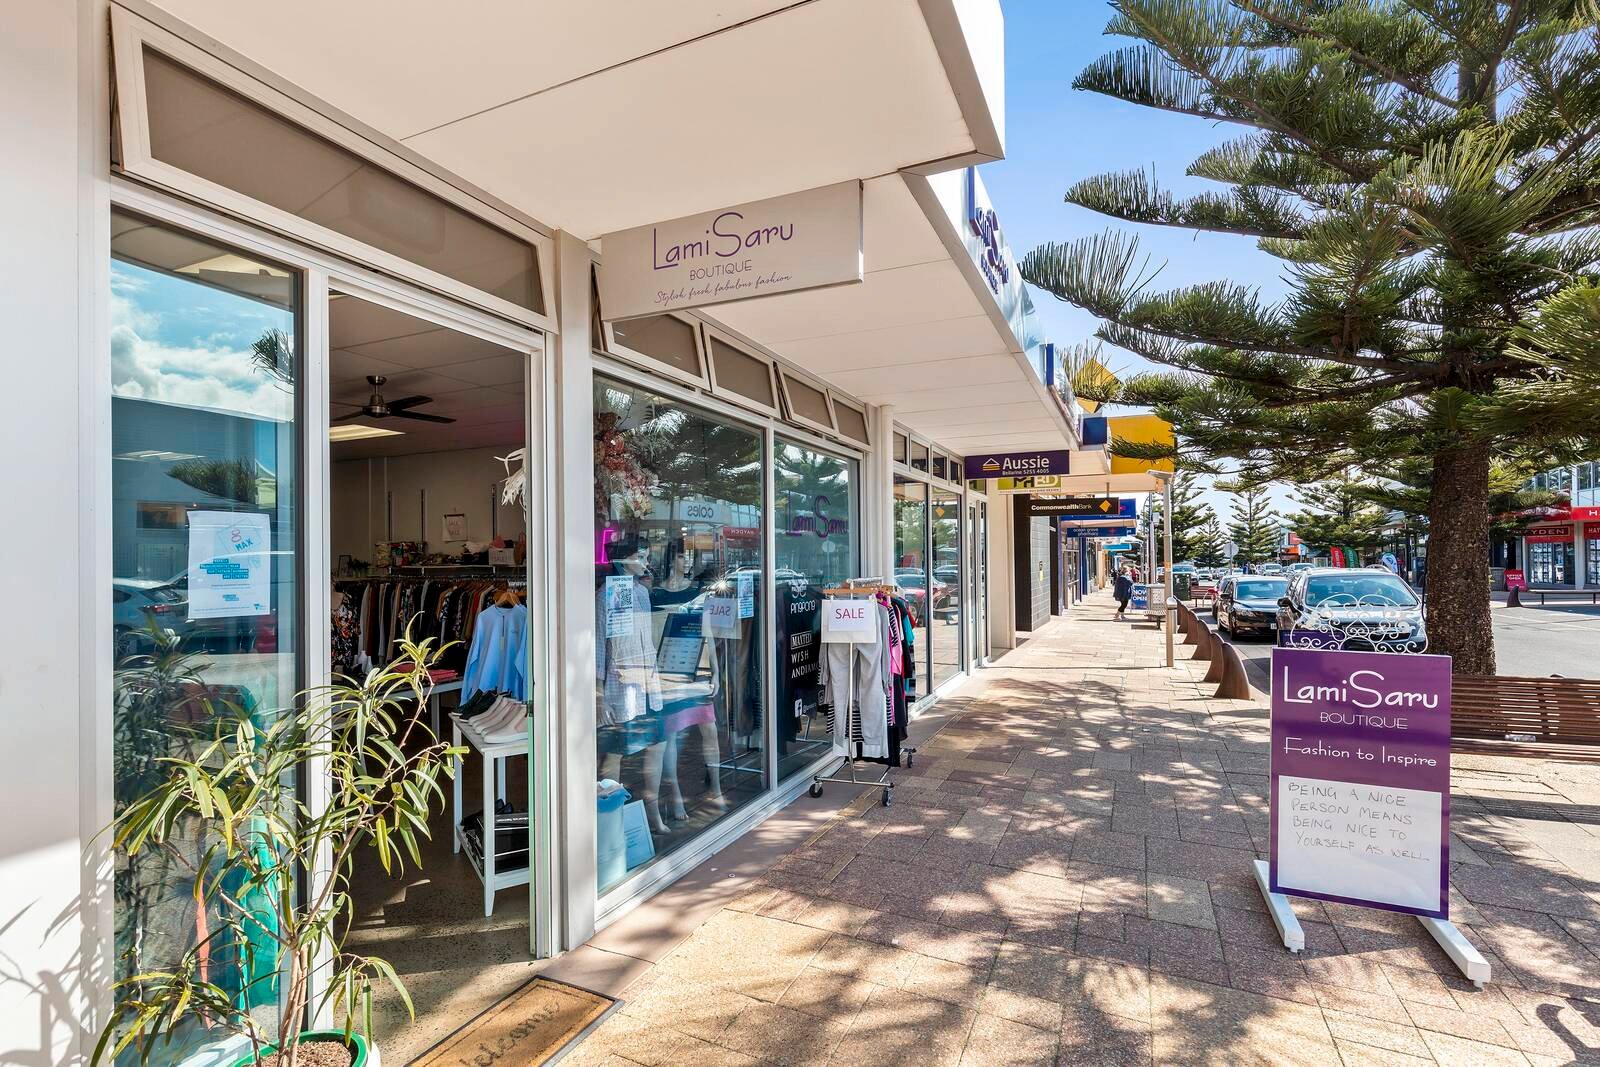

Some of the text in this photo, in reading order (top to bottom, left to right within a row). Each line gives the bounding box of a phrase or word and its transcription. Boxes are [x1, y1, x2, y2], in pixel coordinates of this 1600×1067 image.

[653, 211, 794, 271] LamiSaru
[689, 259, 753, 281] BOUTIQUE
[654, 272, 793, 307] Stylish fresh fabulous fashion
[1002, 455, 1050, 470] Aussie
[1031, 503, 1093, 511] CommonwealthBank
[235, 537, 254, 552] MAX
[835, 607, 865, 620] SALE
[791, 649, 809, 664] WISH
[791, 660, 820, 679] ANDIAM
[1283, 665, 1439, 709] LamiSaru
[1319, 711, 1409, 730] BOUTIQUE
[1283, 736, 1437, 767] Fashion to Inspire
[1288, 782, 1408, 808] BEING A NICE
[1290, 797, 1413, 826] PERSON MEANS
[1293, 815, 1407, 841] BEING NICE TO
[1295, 831, 1355, 849] YOURSELF
[1365, 844, 1384, 856] AS
